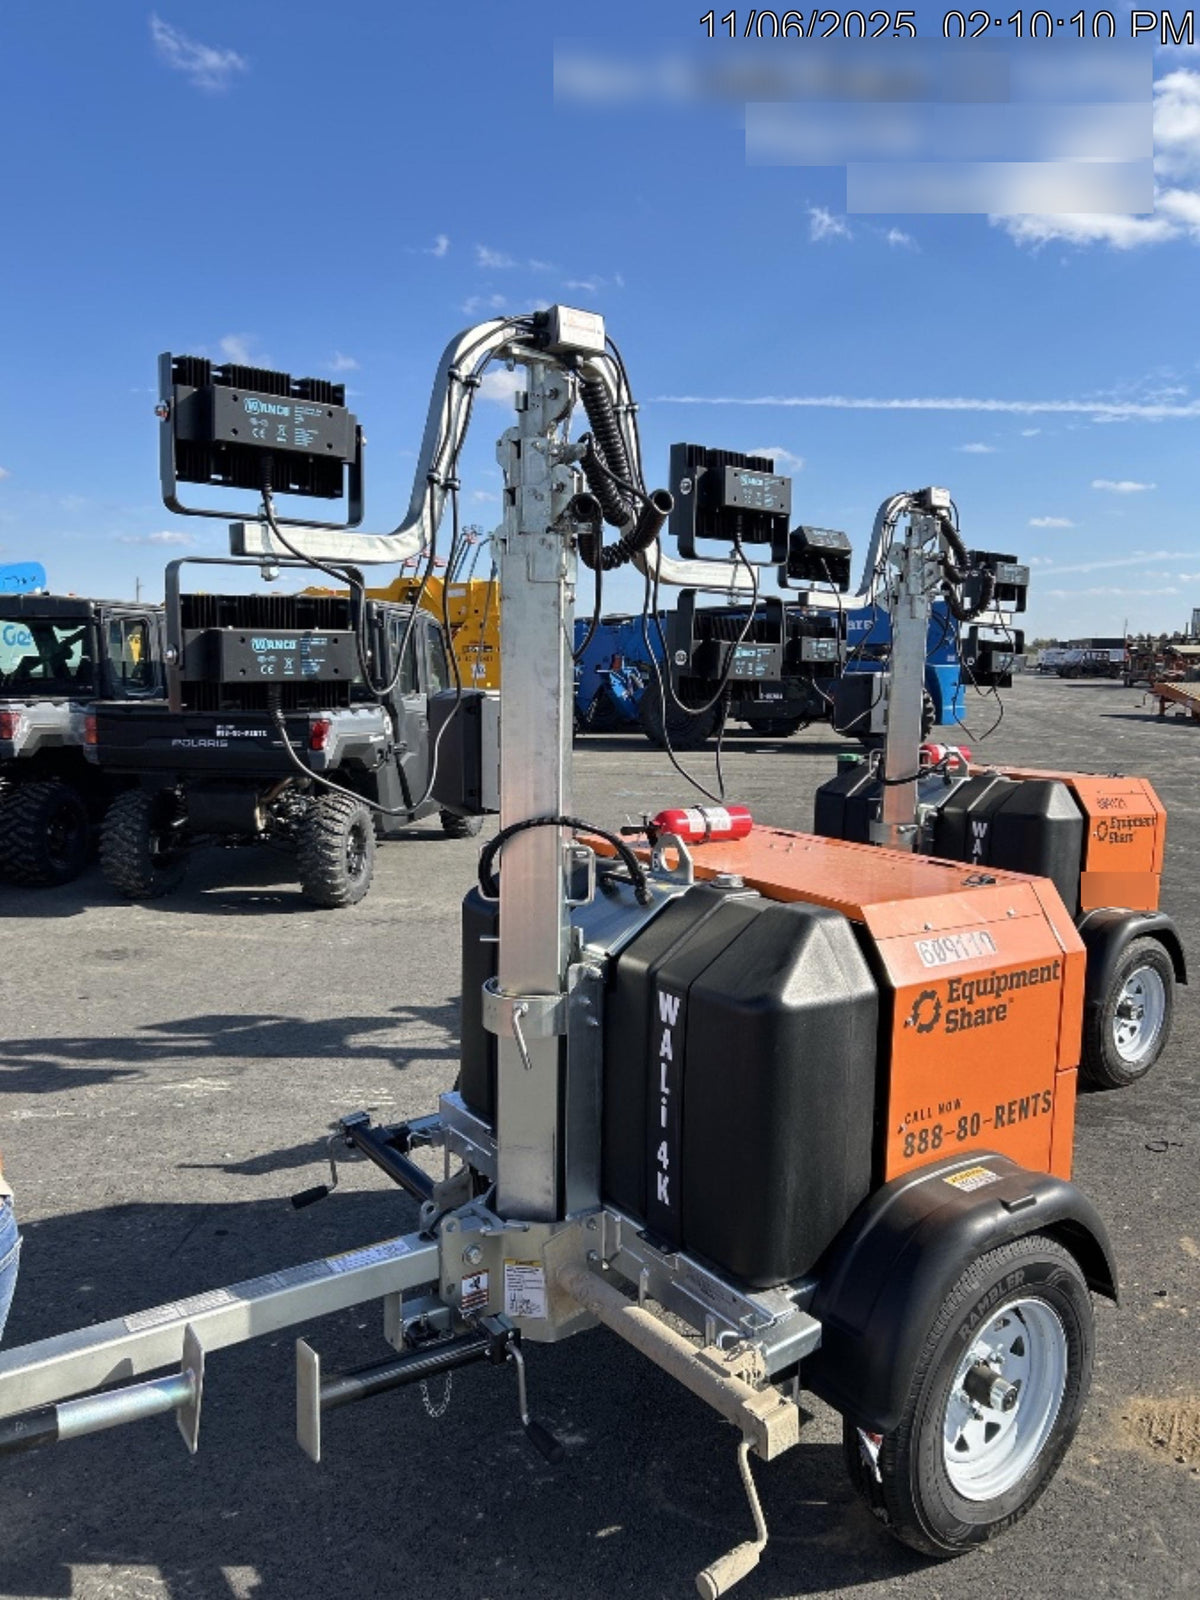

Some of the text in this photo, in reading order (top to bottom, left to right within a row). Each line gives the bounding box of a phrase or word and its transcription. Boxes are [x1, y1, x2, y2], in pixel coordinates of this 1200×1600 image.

[171, 739, 229, 748] POLARIS
[947, 959, 1061, 1005] Equipment
[945, 1003, 1008, 1034] Share
[902, 1089, 1053, 1158] 888-80-RENTS
[904, 1098, 962, 1125] CALL NOW
[957, 1269, 1026, 1342] RAMBLER
